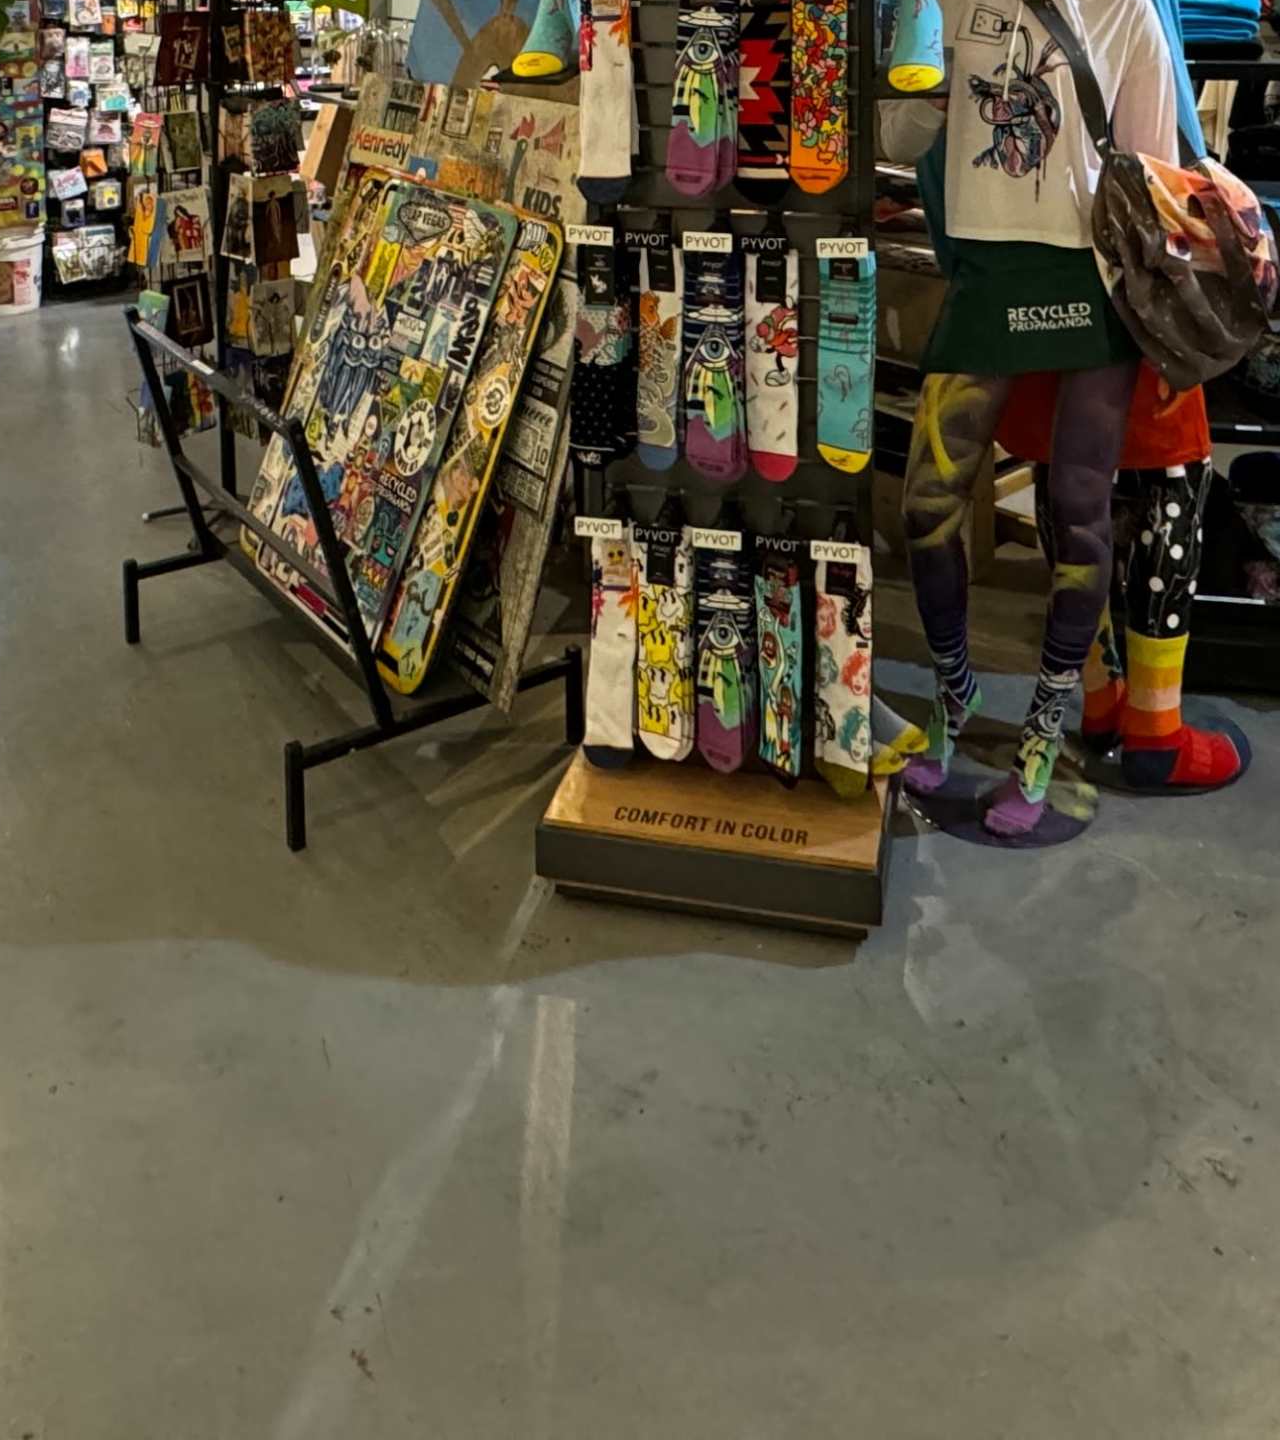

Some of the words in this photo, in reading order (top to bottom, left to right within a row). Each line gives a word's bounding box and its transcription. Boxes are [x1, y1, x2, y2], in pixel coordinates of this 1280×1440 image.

[353, 127, 410, 165] Kennedy
[522, 186, 562, 219] KIDS
[568, 227, 611, 242] PYVOT
[624, 232, 669, 247] PYVOT
[685, 235, 729, 248] PYVOT
[740, 237, 787, 250] PYVOT
[819, 242, 865, 254] PYVOT
[1007, 302, 1091, 321] RECYCLED
[1008, 317, 1093, 332] PROPAGANDA
[577, 520, 619, 535] PYVOT
[635, 527, 679, 543] PYVOT
[694, 532, 737, 546] PYVOT
[755, 536, 800, 552] PYVOT
[814, 545, 859, 559] PYVOT
[614, 806, 713, 833] COMFORT
[714, 818, 737, 836] IN
[741, 822, 809, 846] COLOR
